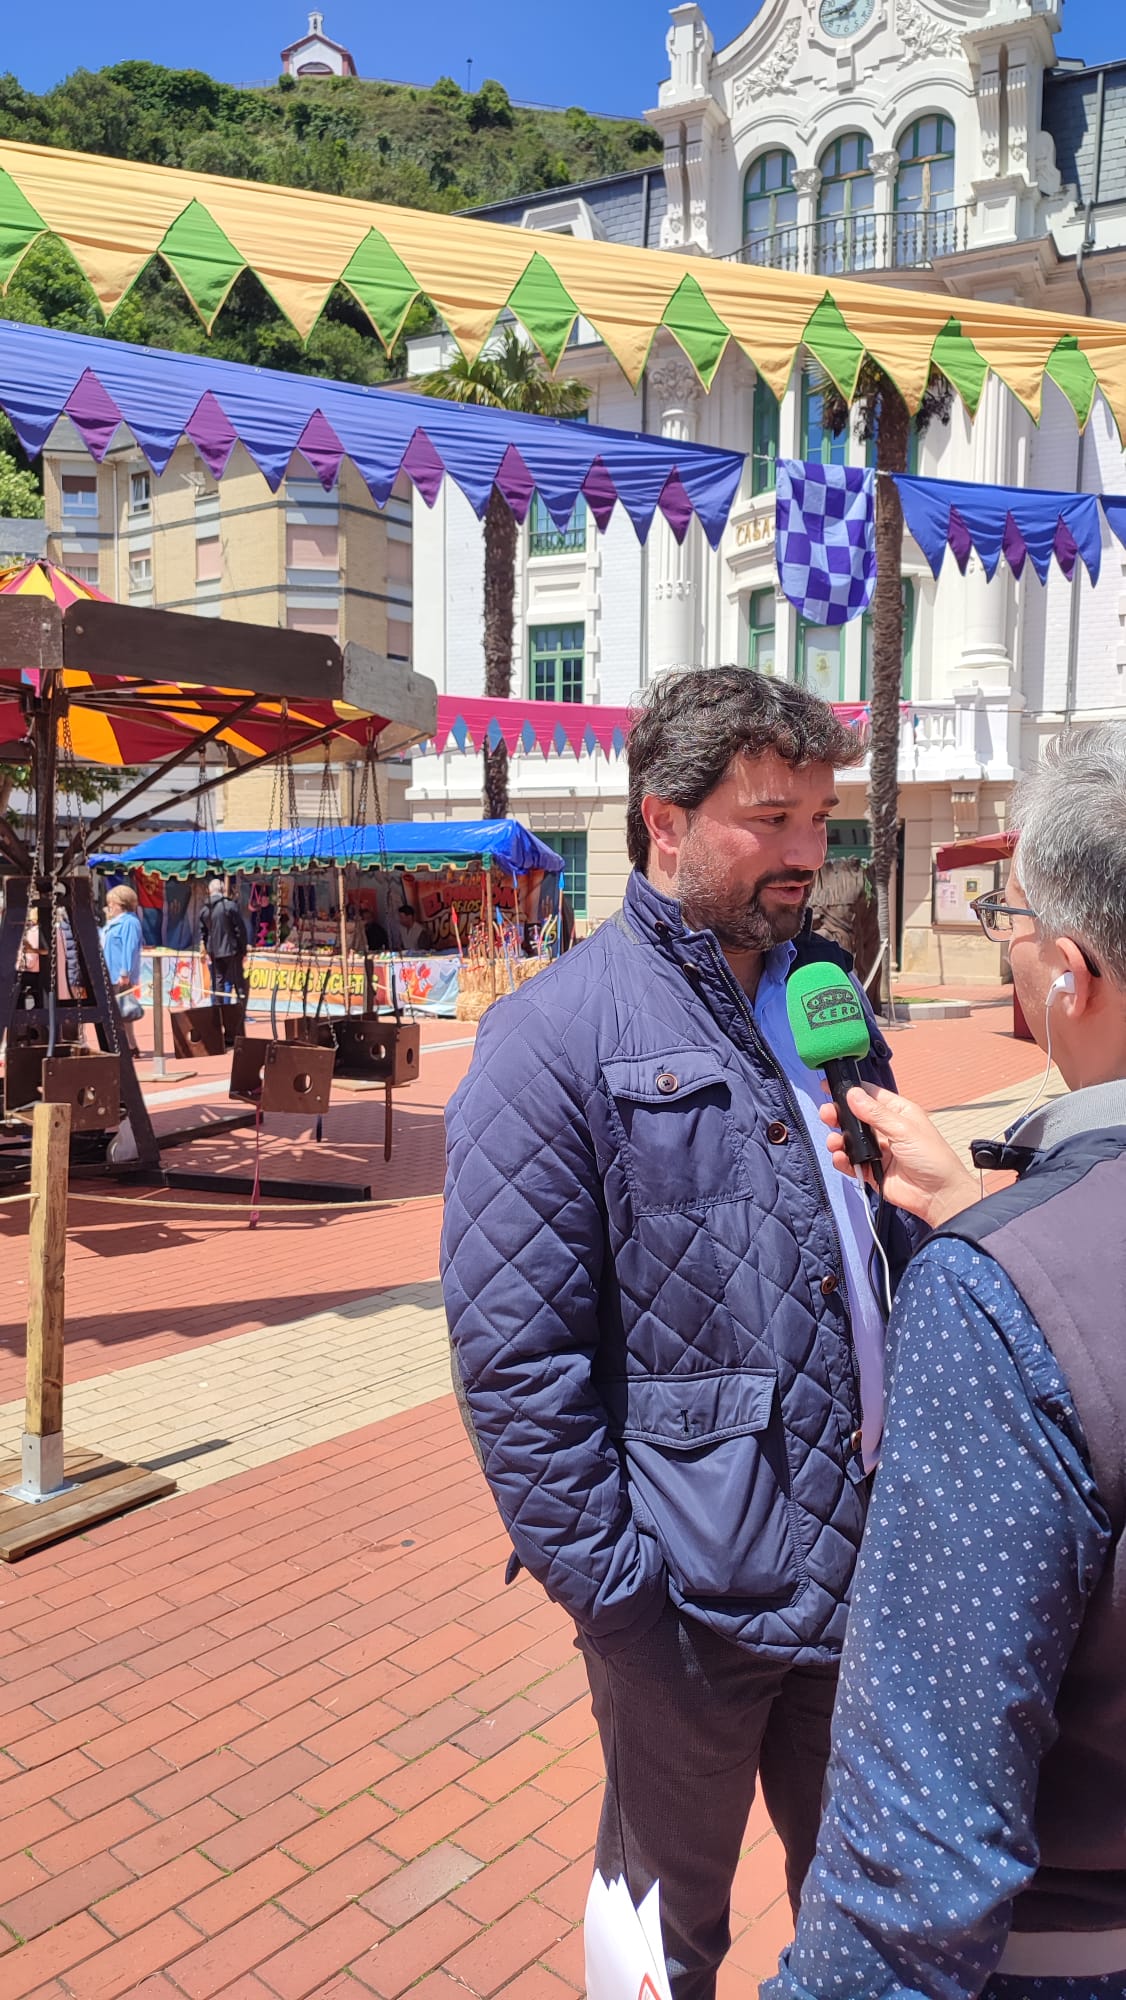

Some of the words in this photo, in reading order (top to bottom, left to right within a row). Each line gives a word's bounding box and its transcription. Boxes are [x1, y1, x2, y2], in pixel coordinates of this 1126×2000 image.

[736, 517, 771, 547] CASA
[270, 970, 287, 990] DE
[811, 992, 851, 1006] ONDA
[819, 1006, 855, 1020] CERO
